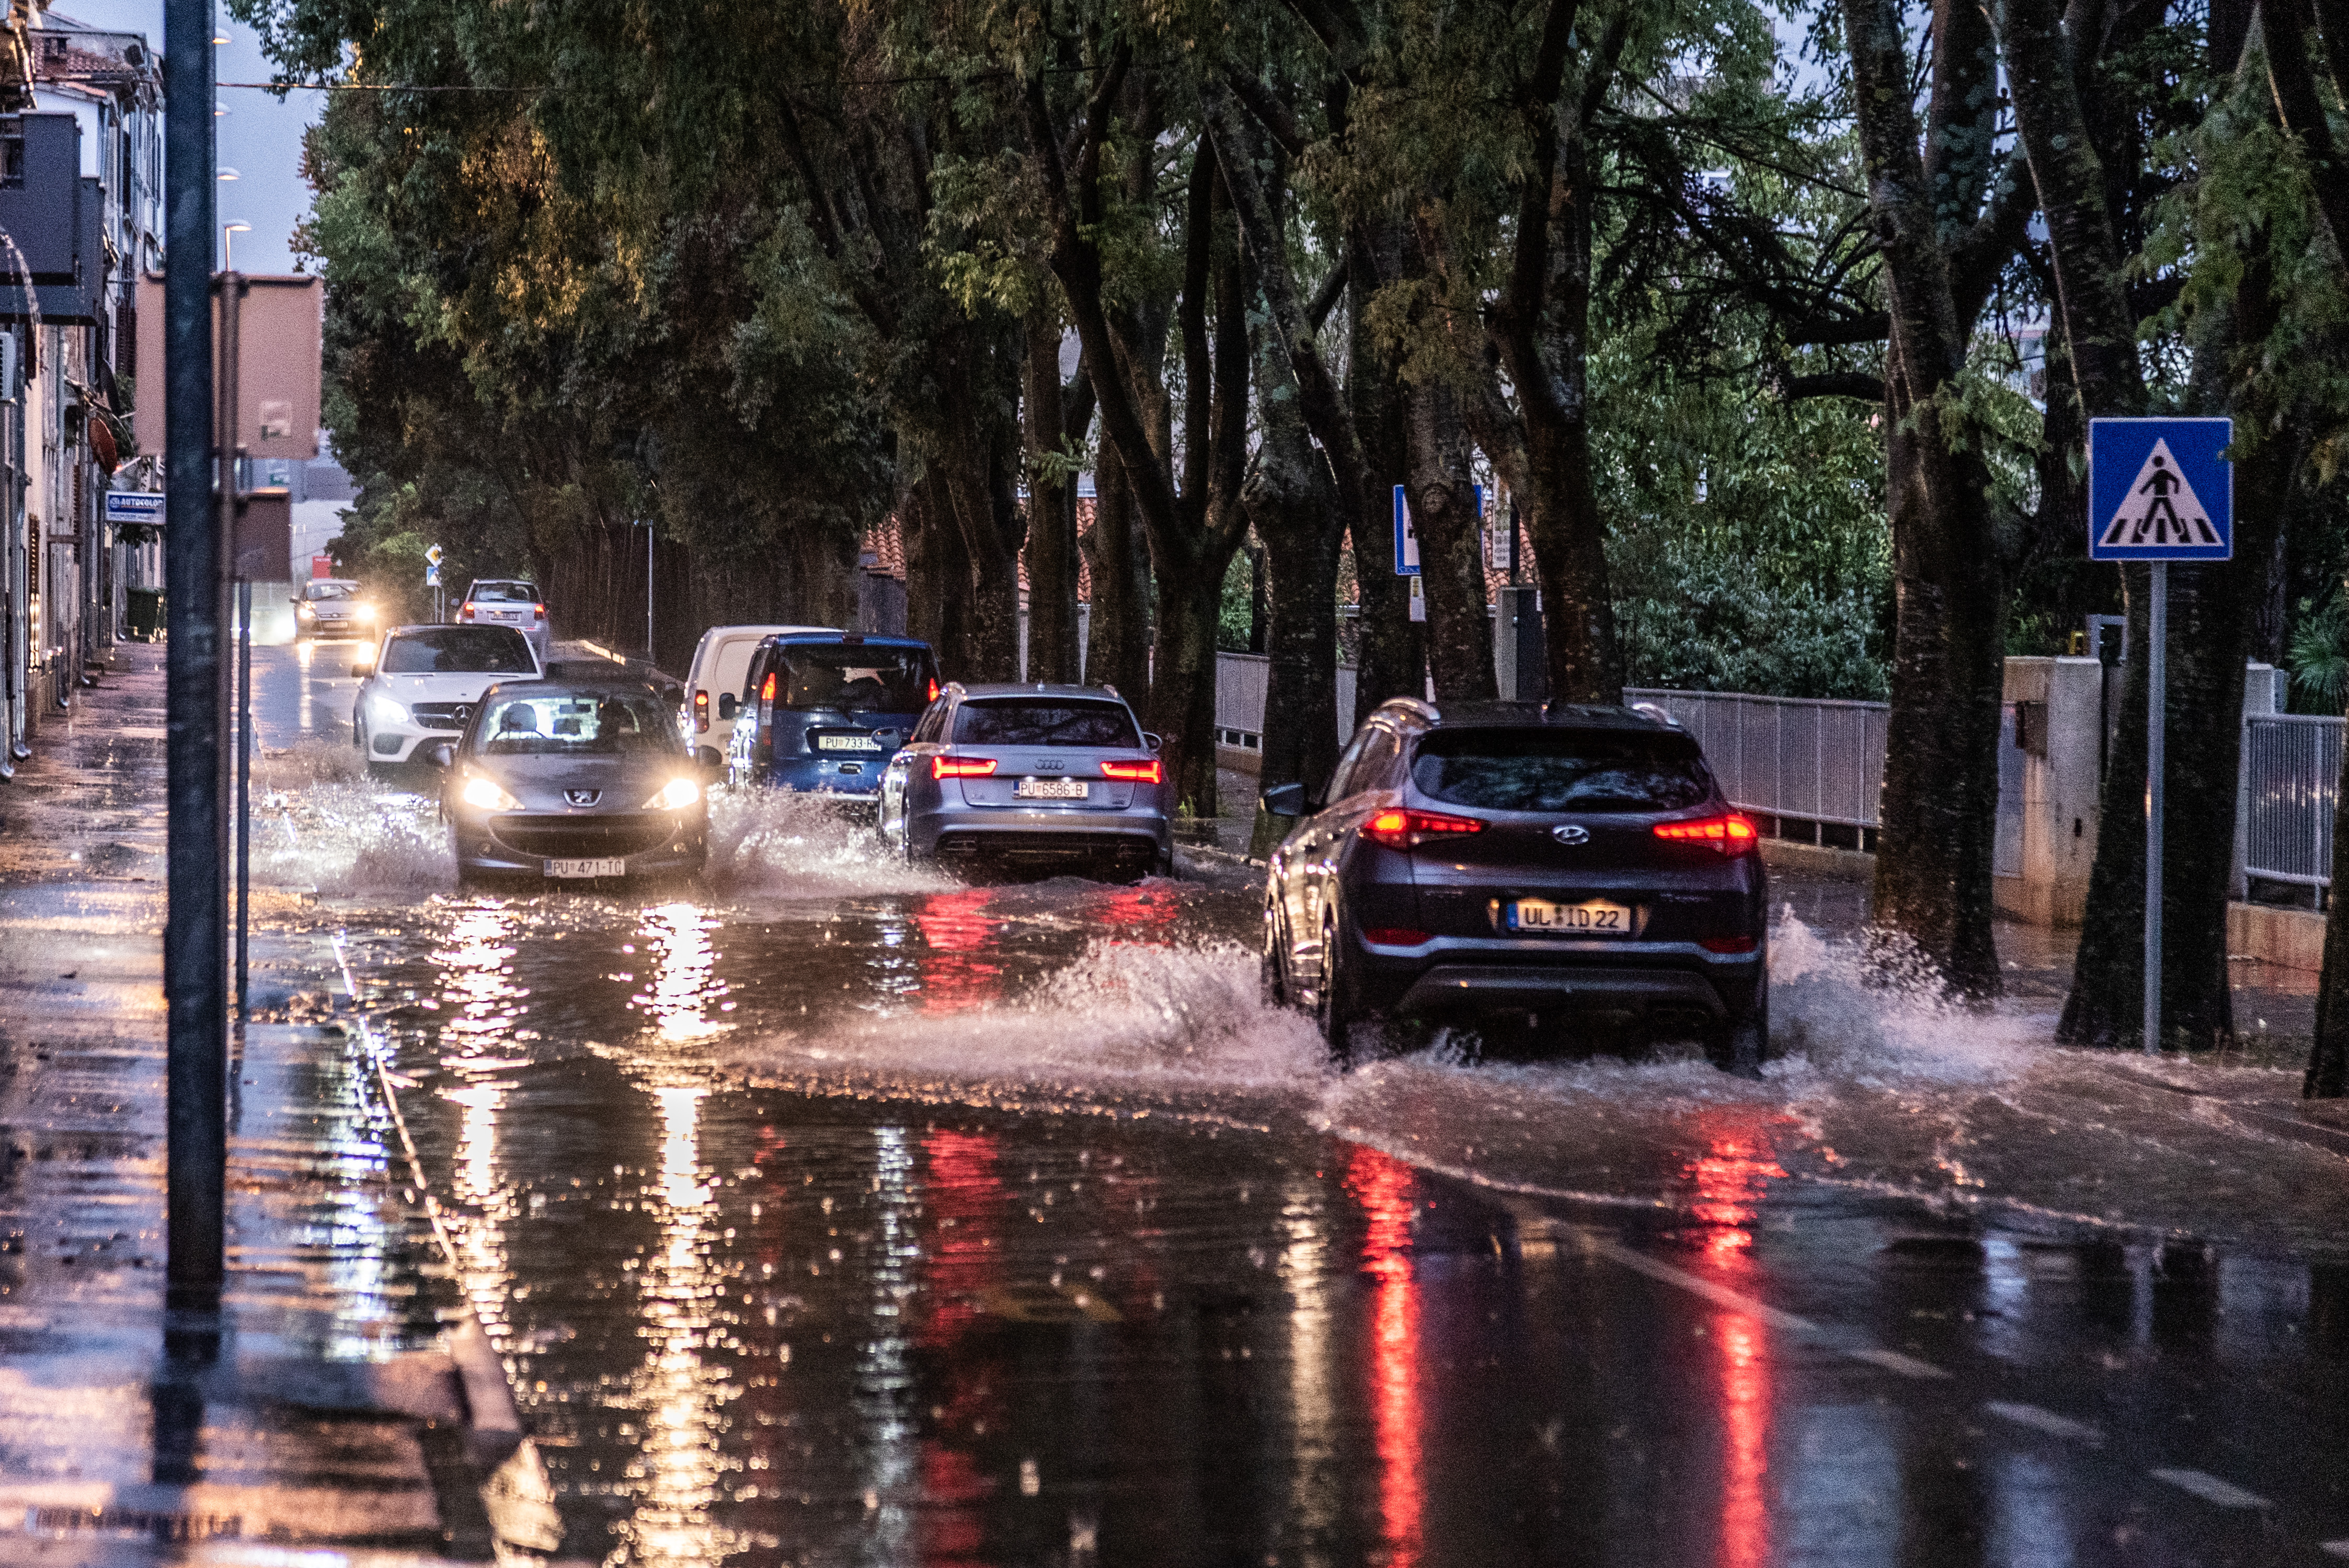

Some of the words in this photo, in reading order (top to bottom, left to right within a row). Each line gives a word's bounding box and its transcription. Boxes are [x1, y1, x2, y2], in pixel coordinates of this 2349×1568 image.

[826, 738, 838, 748] PU
[1021, 783, 1035, 795] PU
[1042, 783, 1082, 795] 6586-B
[553, 862, 568, 874] PU
[1525, 907, 1550, 925] UL
[1567, 908, 1590, 927] ID
[1595, 910, 1619, 929] 22
